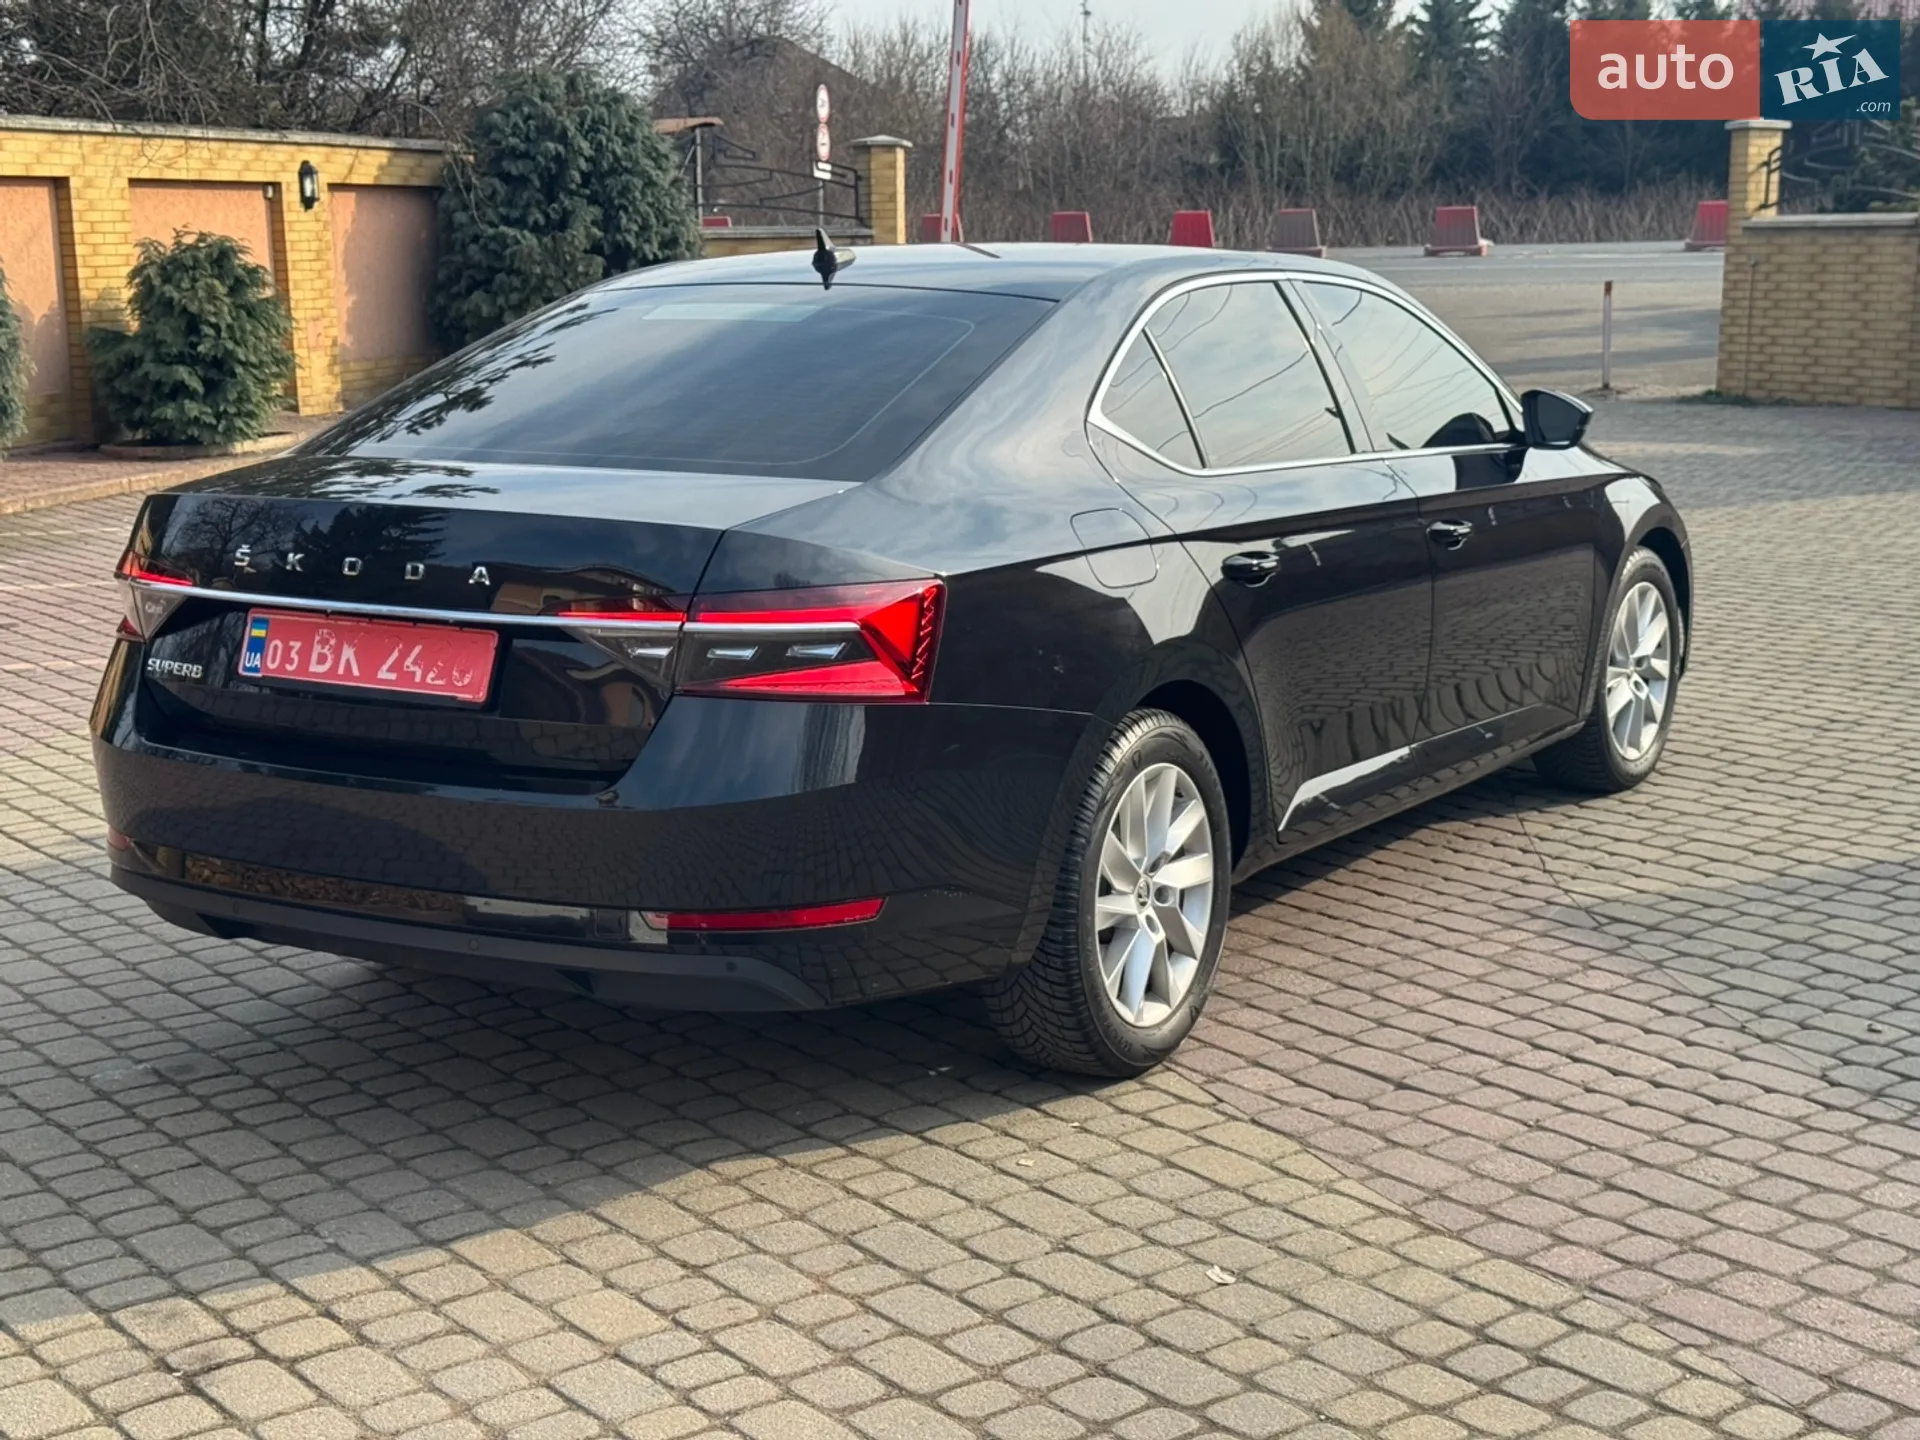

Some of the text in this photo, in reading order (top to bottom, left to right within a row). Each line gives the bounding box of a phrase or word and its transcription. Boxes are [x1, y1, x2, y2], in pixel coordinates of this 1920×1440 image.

[233, 544, 492, 586] ŠKODA
[146, 657, 204, 679] SUPERB
[244, 651, 261, 669] UA
[265, 638, 303, 672] 03
